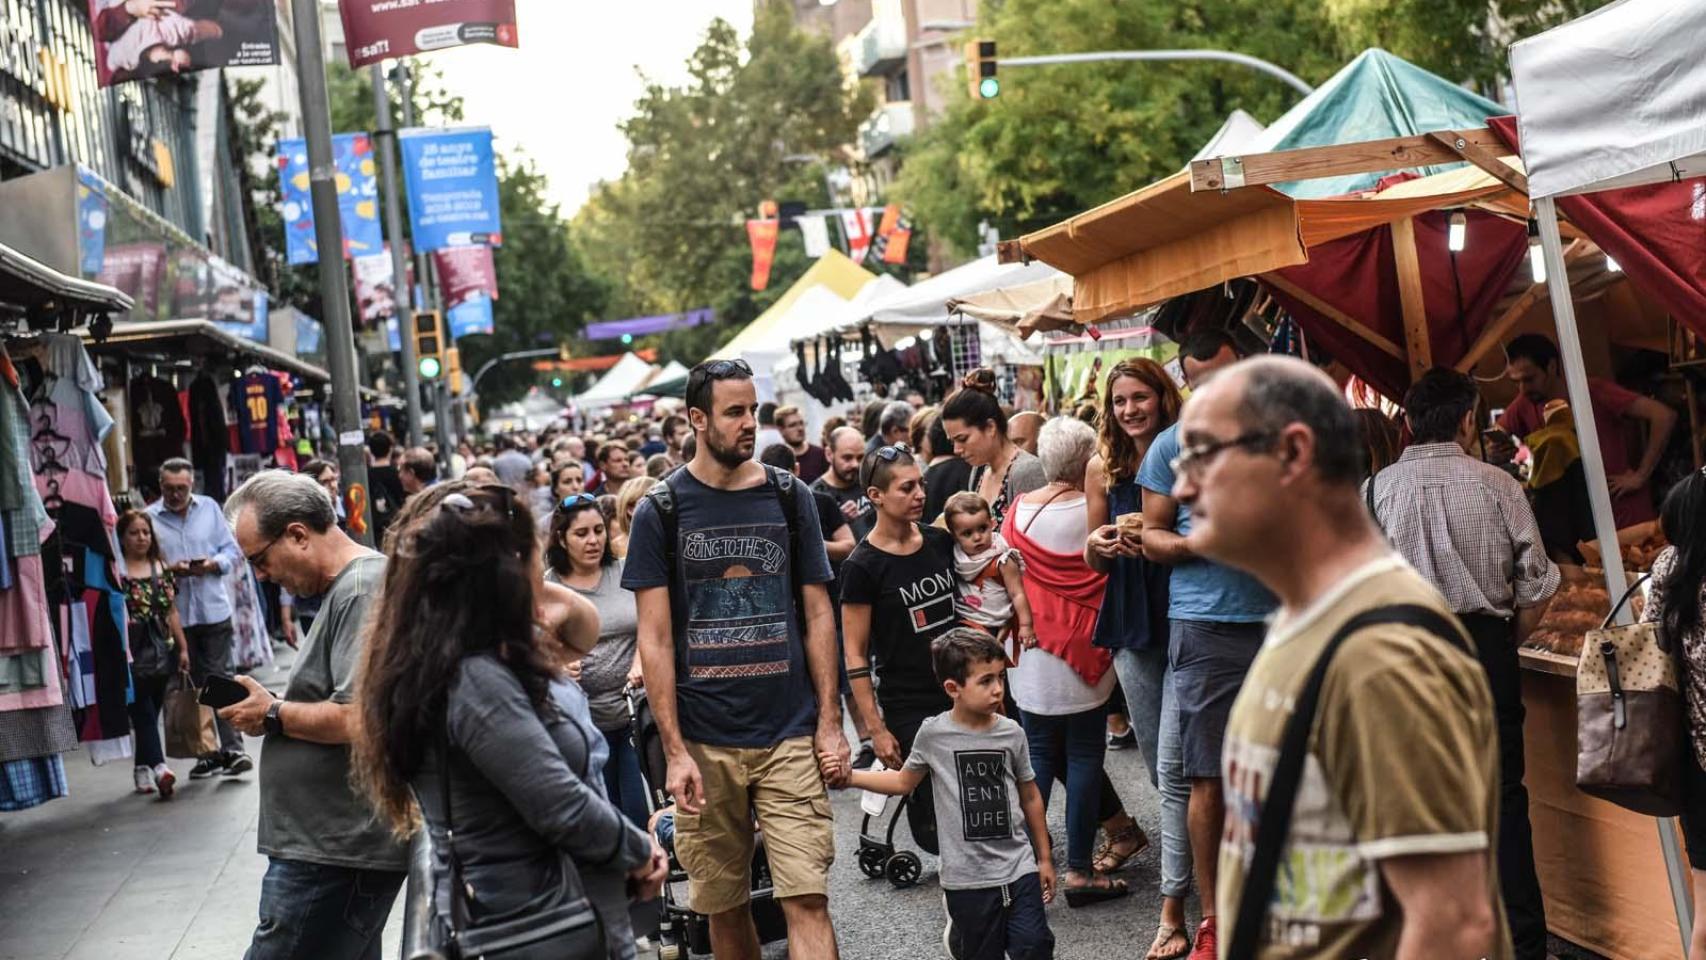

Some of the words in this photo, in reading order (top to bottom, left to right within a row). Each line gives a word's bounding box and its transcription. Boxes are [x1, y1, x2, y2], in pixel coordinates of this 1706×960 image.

[246, 396, 268, 421] 10
[899, 567, 955, 606] MOM
[965, 762, 1000, 777] ADV
[968, 785, 1001, 802] ENT
[969, 810, 1006, 828] URE
